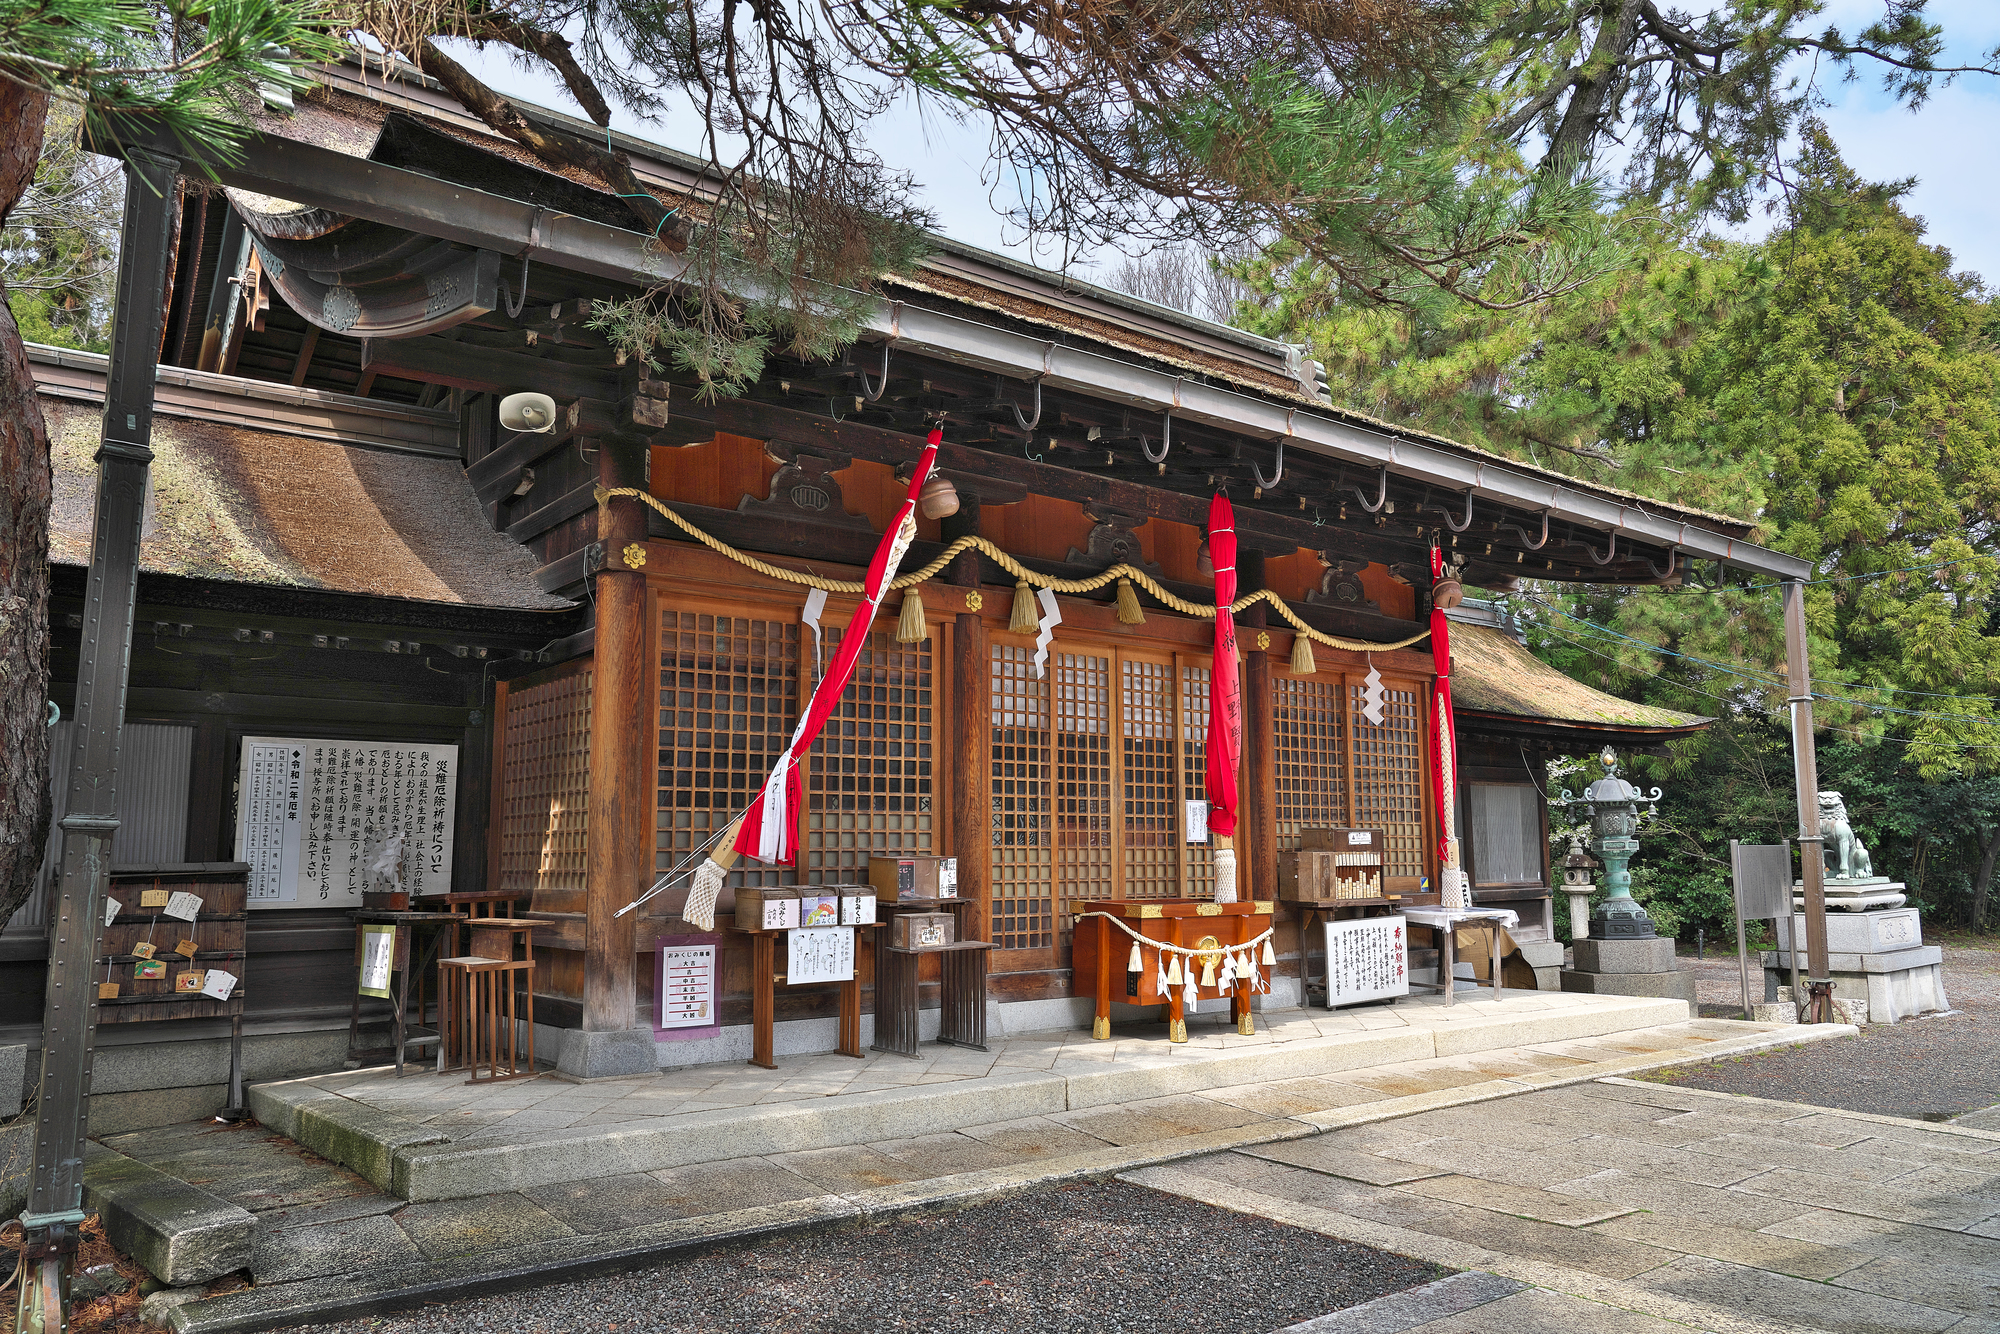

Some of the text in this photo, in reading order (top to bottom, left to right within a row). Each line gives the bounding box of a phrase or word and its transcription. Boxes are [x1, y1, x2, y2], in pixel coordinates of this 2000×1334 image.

[255, 762, 261, 773] 昭和
[267, 762, 273, 773] 昭和
[668, 951, 711, 959] おみくじの順番
